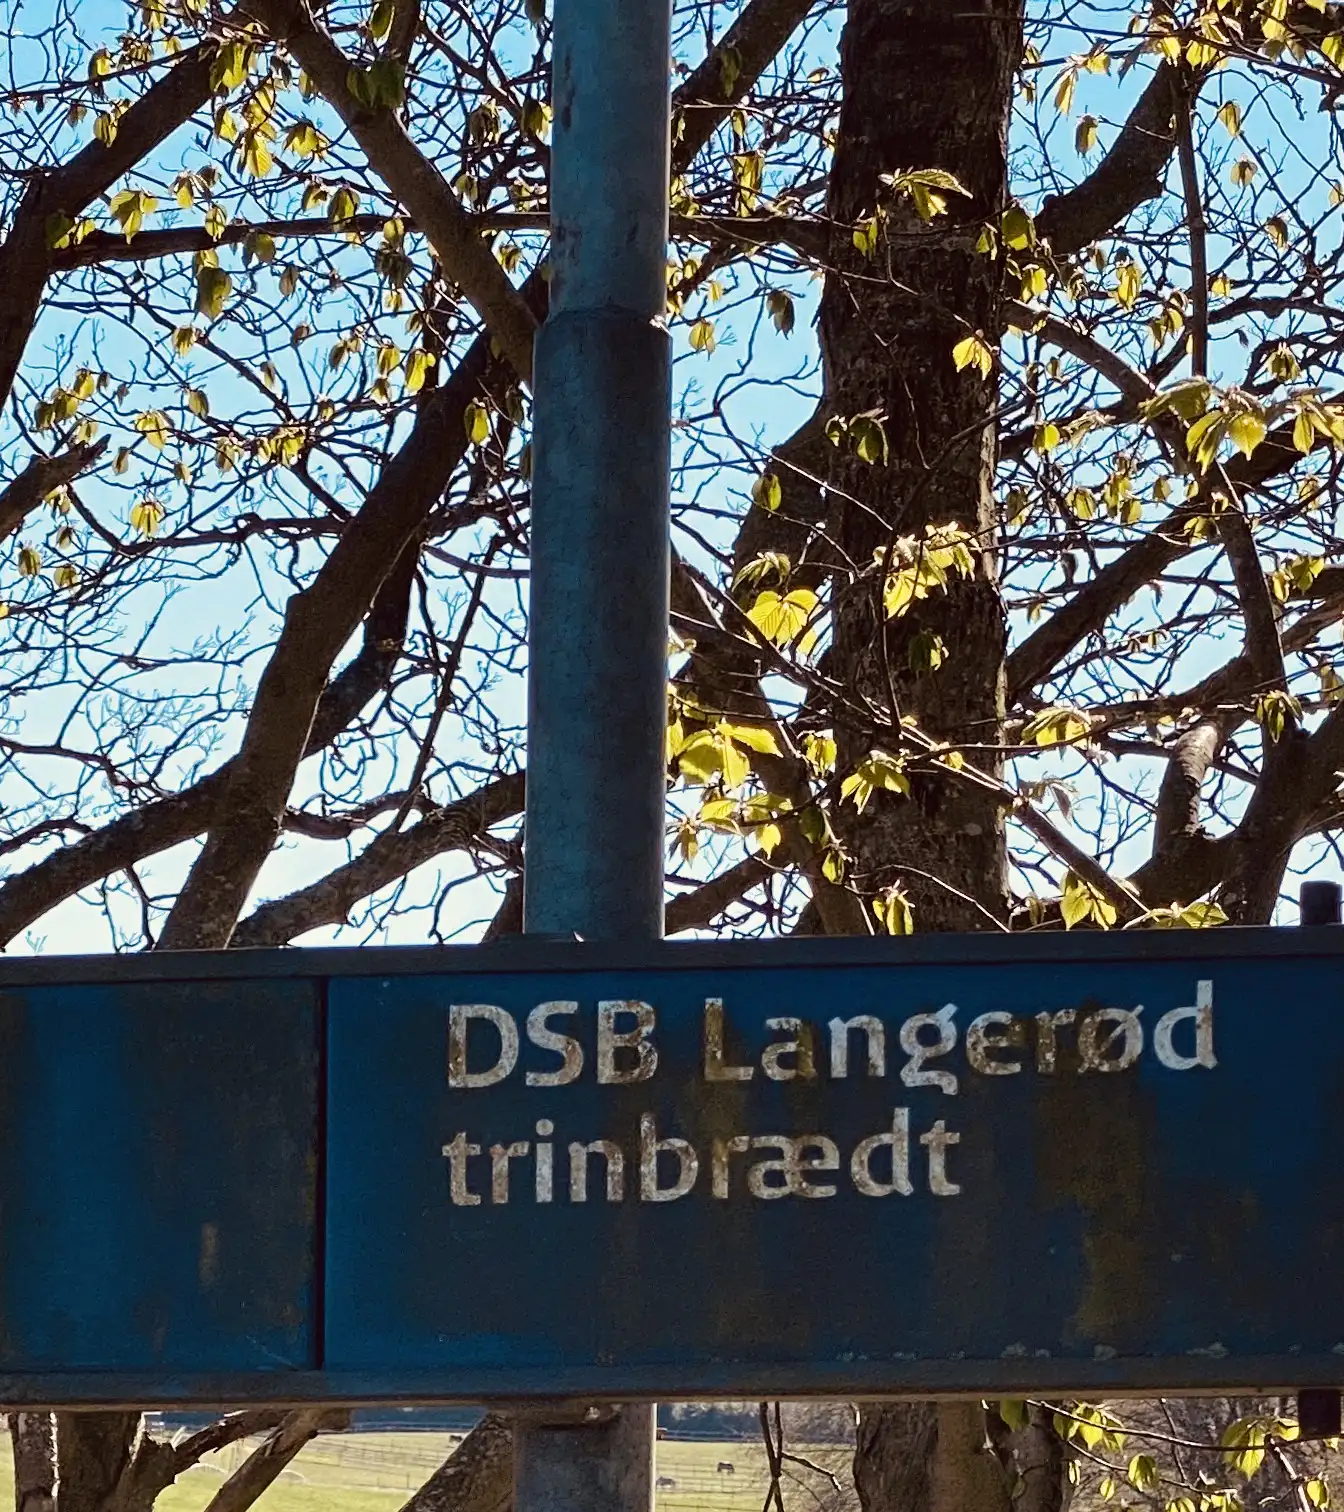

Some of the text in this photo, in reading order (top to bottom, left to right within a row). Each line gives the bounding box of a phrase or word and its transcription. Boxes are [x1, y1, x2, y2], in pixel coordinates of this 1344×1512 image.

[447, 979, 1219, 1096] DSB Langerød
[441, 1106, 963, 1207] trinbrædt
